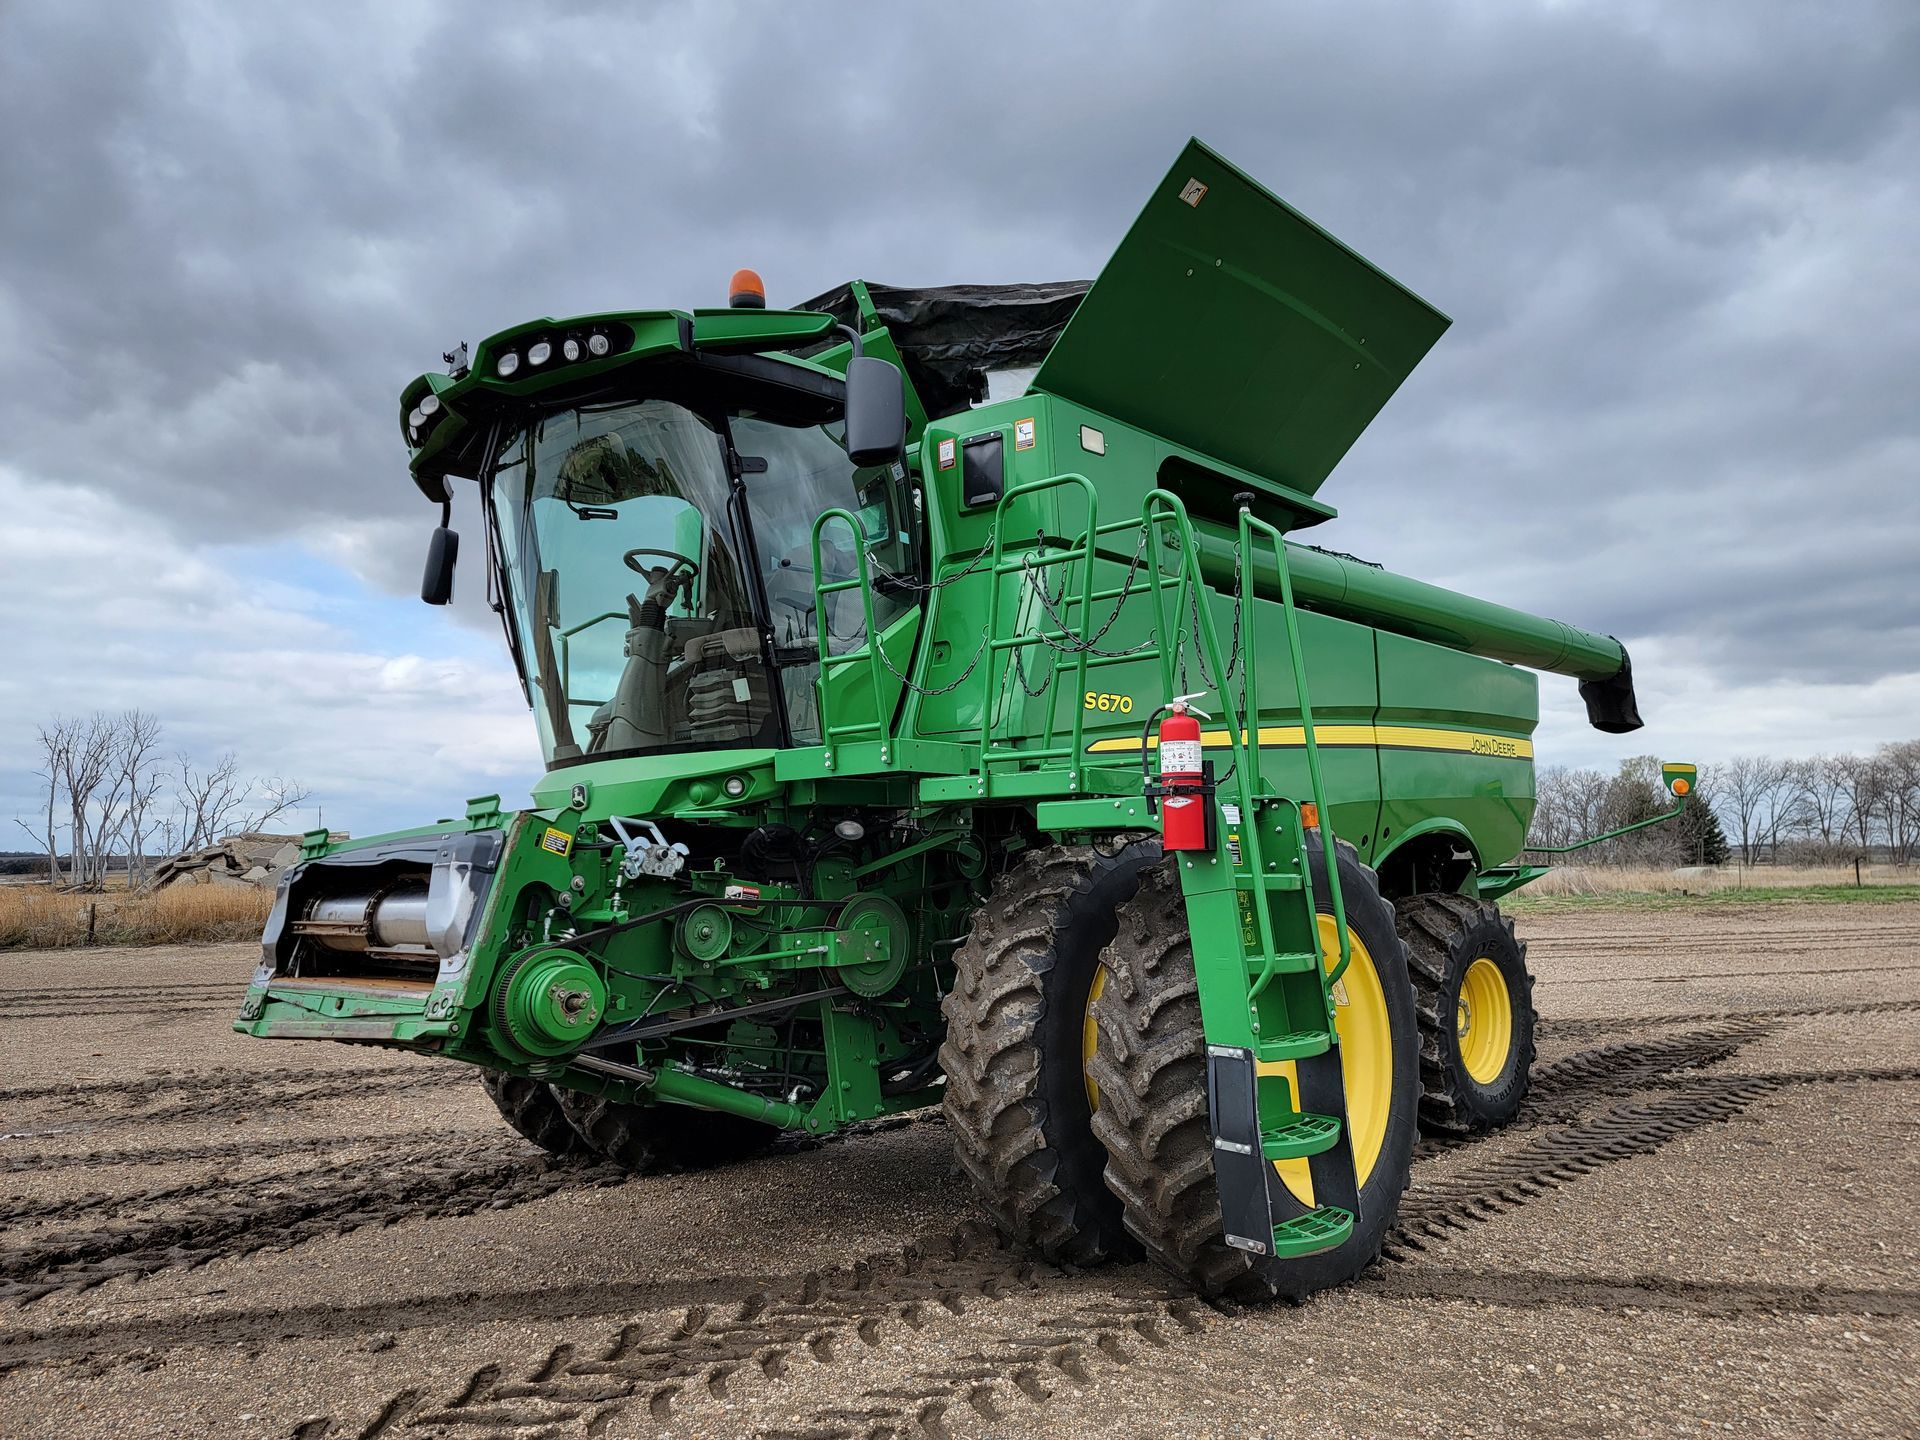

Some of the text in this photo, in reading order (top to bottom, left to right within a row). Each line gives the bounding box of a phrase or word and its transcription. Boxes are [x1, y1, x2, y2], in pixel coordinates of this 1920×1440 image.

[1084, 691, 1133, 714] S670
[1471, 736, 1517, 756] JOHN DEERE
